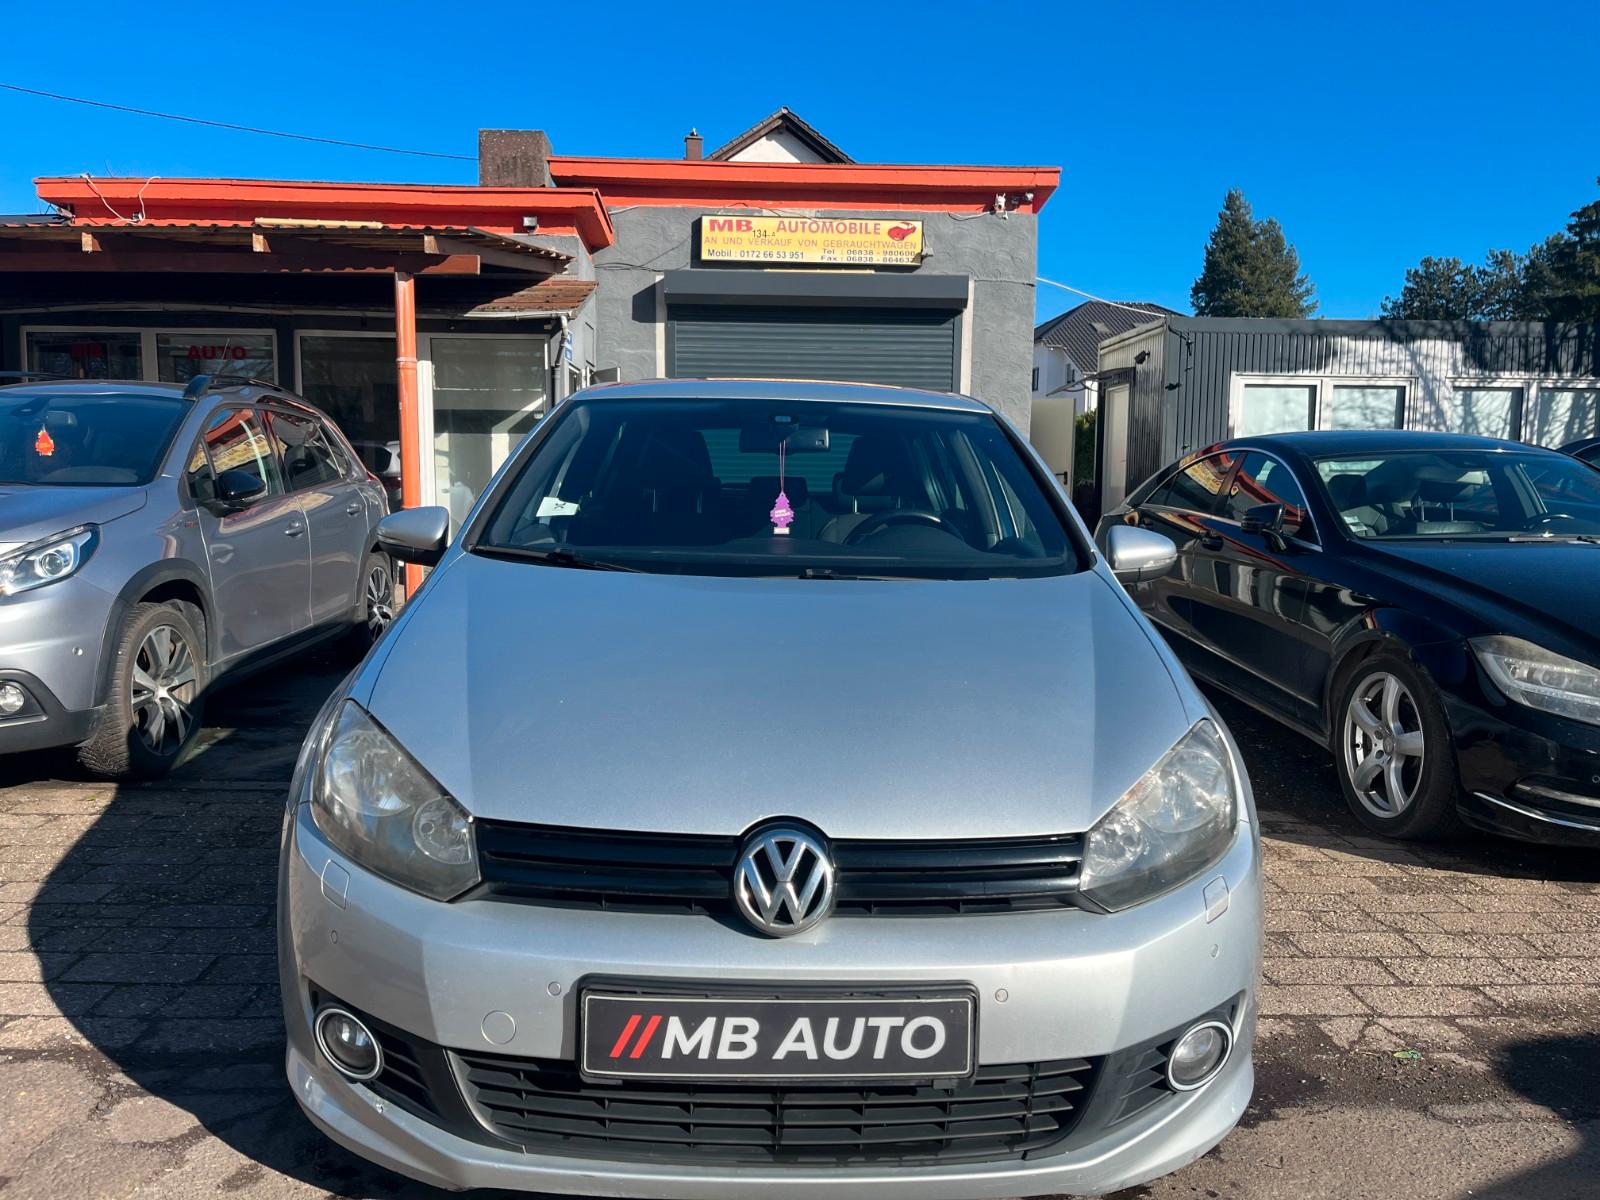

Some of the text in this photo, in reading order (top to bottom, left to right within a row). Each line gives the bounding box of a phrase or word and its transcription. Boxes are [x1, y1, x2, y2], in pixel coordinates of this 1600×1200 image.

[709, 219, 881, 234] MB AUTOMOBILE
[704, 236, 917, 249] AN UND VERKAUF VON GEBRAUCHTWAGEN
[740, 250, 761, 258] 0172
[763, 250, 774, 258] 66
[776, 250, 787, 259] 53
[789, 251, 804, 259] 951
[188, 345, 247, 360] AUTO
[772, 1015, 946, 1060] AUTO
